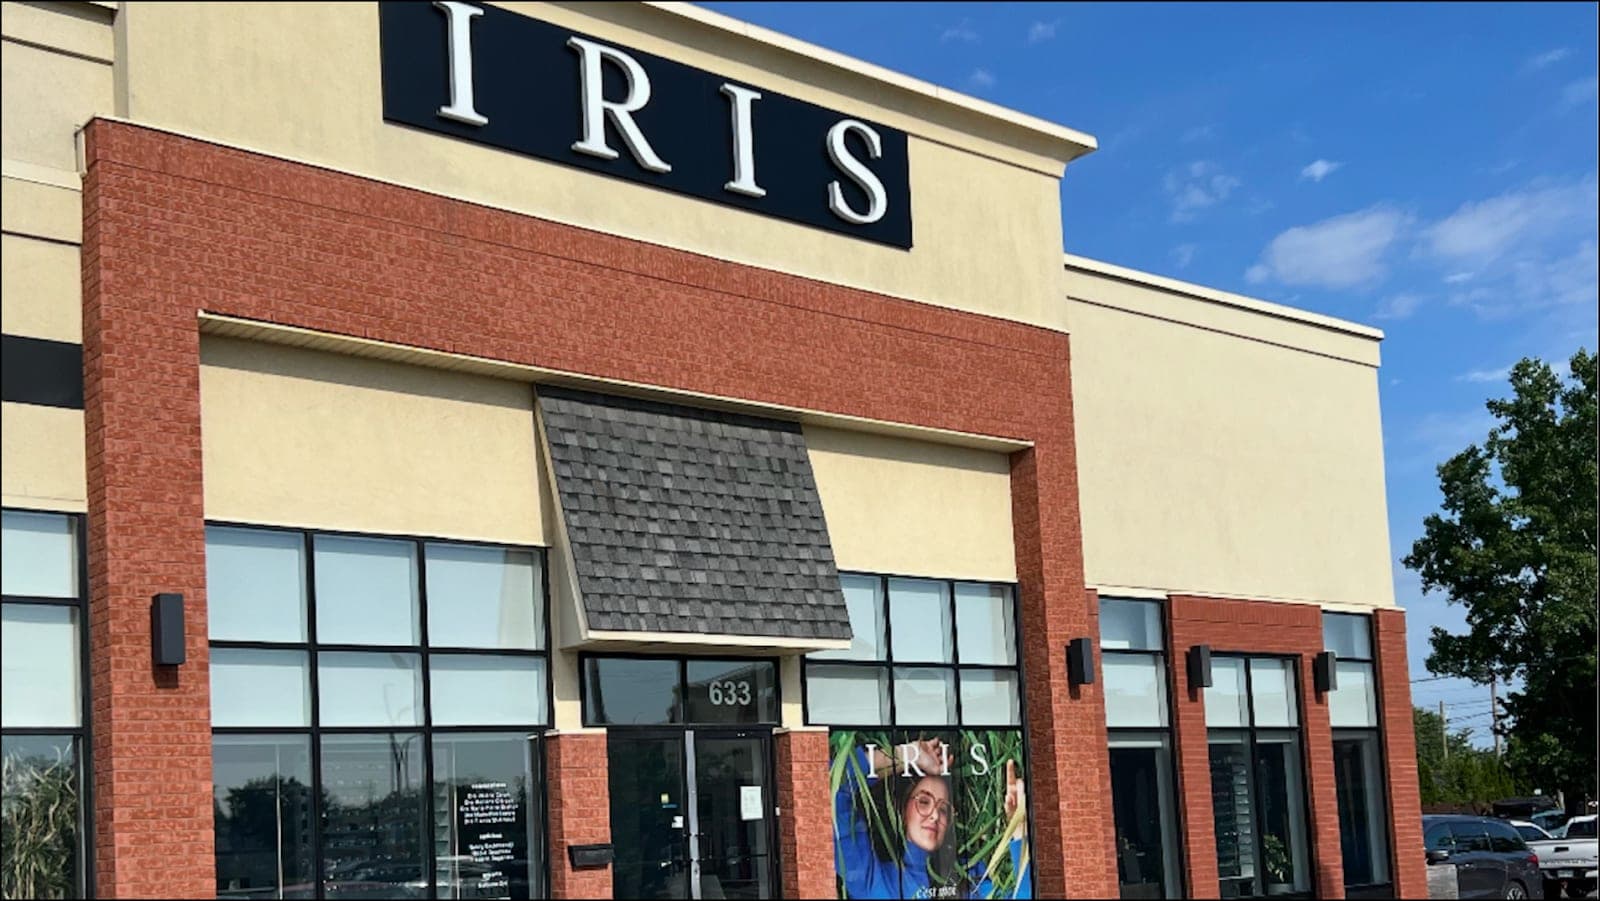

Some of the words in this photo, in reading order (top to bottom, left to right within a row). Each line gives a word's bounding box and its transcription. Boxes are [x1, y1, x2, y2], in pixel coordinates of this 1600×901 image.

[433, 1, 888, 224] IRIS
[709, 681, 752, 705] 633
[865, 743, 989, 778] IRIS
